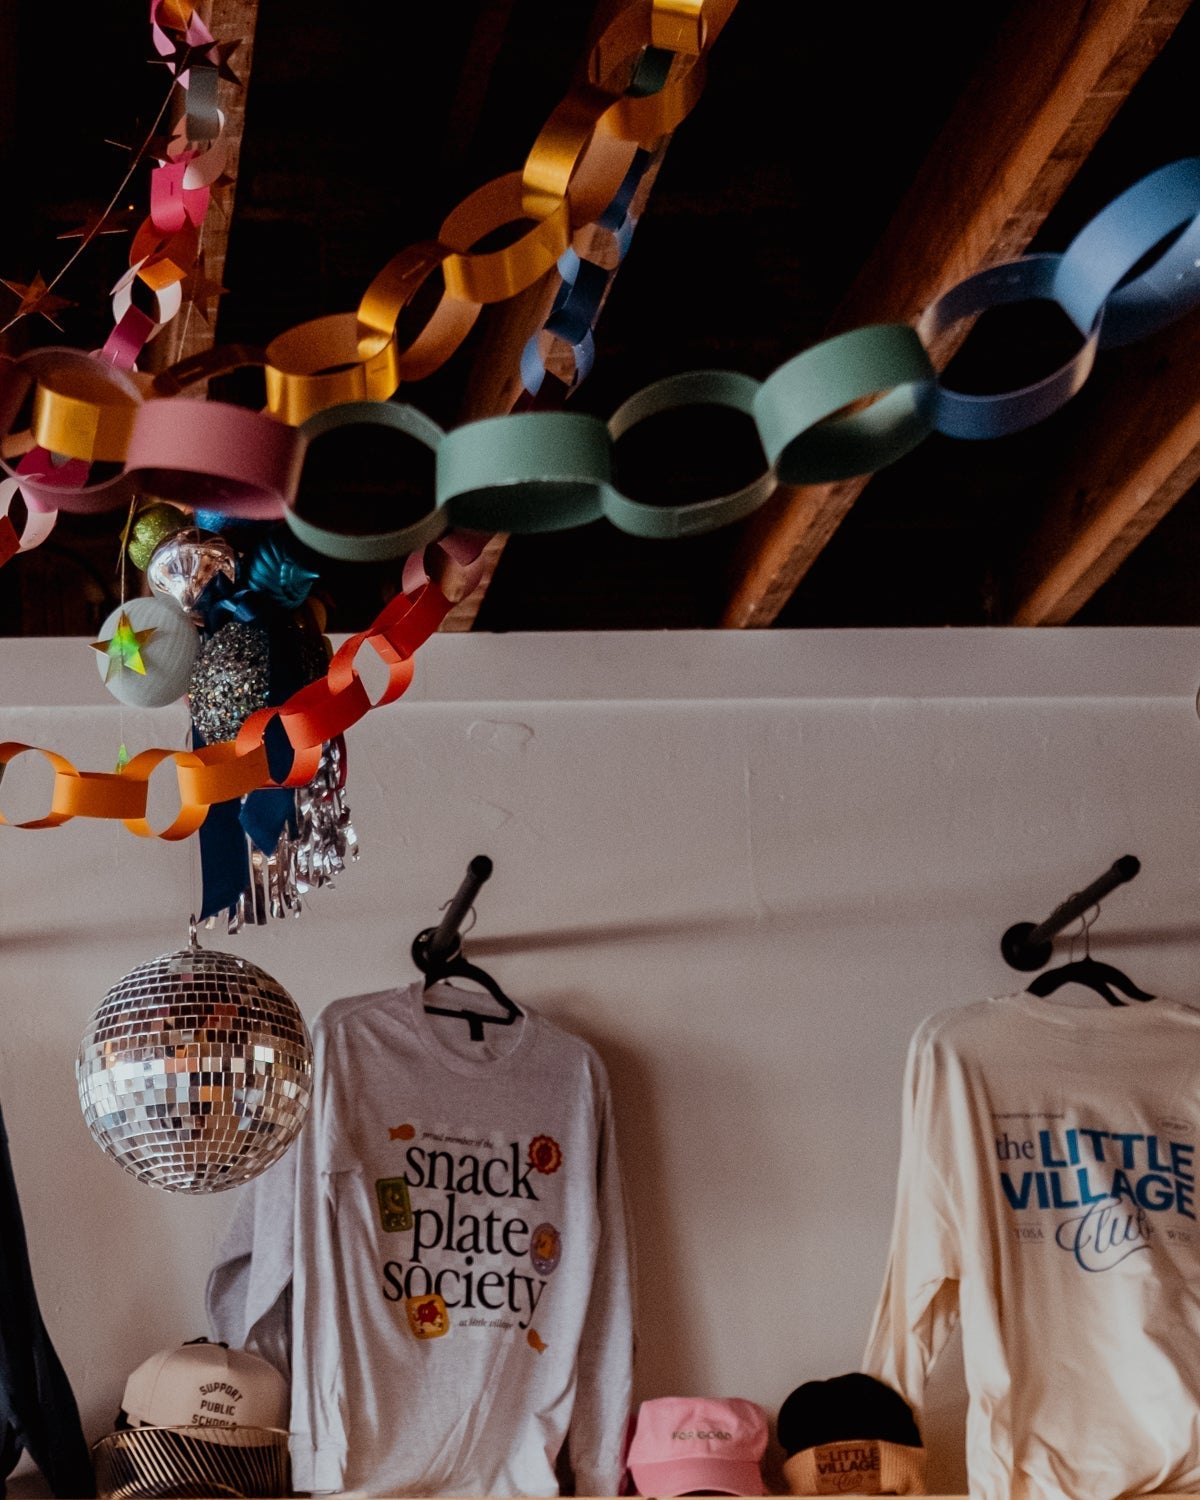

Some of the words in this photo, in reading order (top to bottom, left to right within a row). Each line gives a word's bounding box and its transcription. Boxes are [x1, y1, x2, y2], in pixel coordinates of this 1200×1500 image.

[403, 1143, 539, 1201] snack
[995, 1134, 1036, 1161] the
[1039, 1129, 1195, 1182] LITTLE
[1000, 1167, 1196, 1221] VILLAGE
[409, 1193, 529, 1263] plate
[1055, 1197, 1154, 1273] Club
[382, 1256, 548, 1329] society
[199, 1382, 243, 1402] SUPPORT
[200, 1400, 236, 1416] PUBLIC
[817, 1460, 880, 1475] VILLAGE
[829, 1447, 879, 1461] LITTLE
